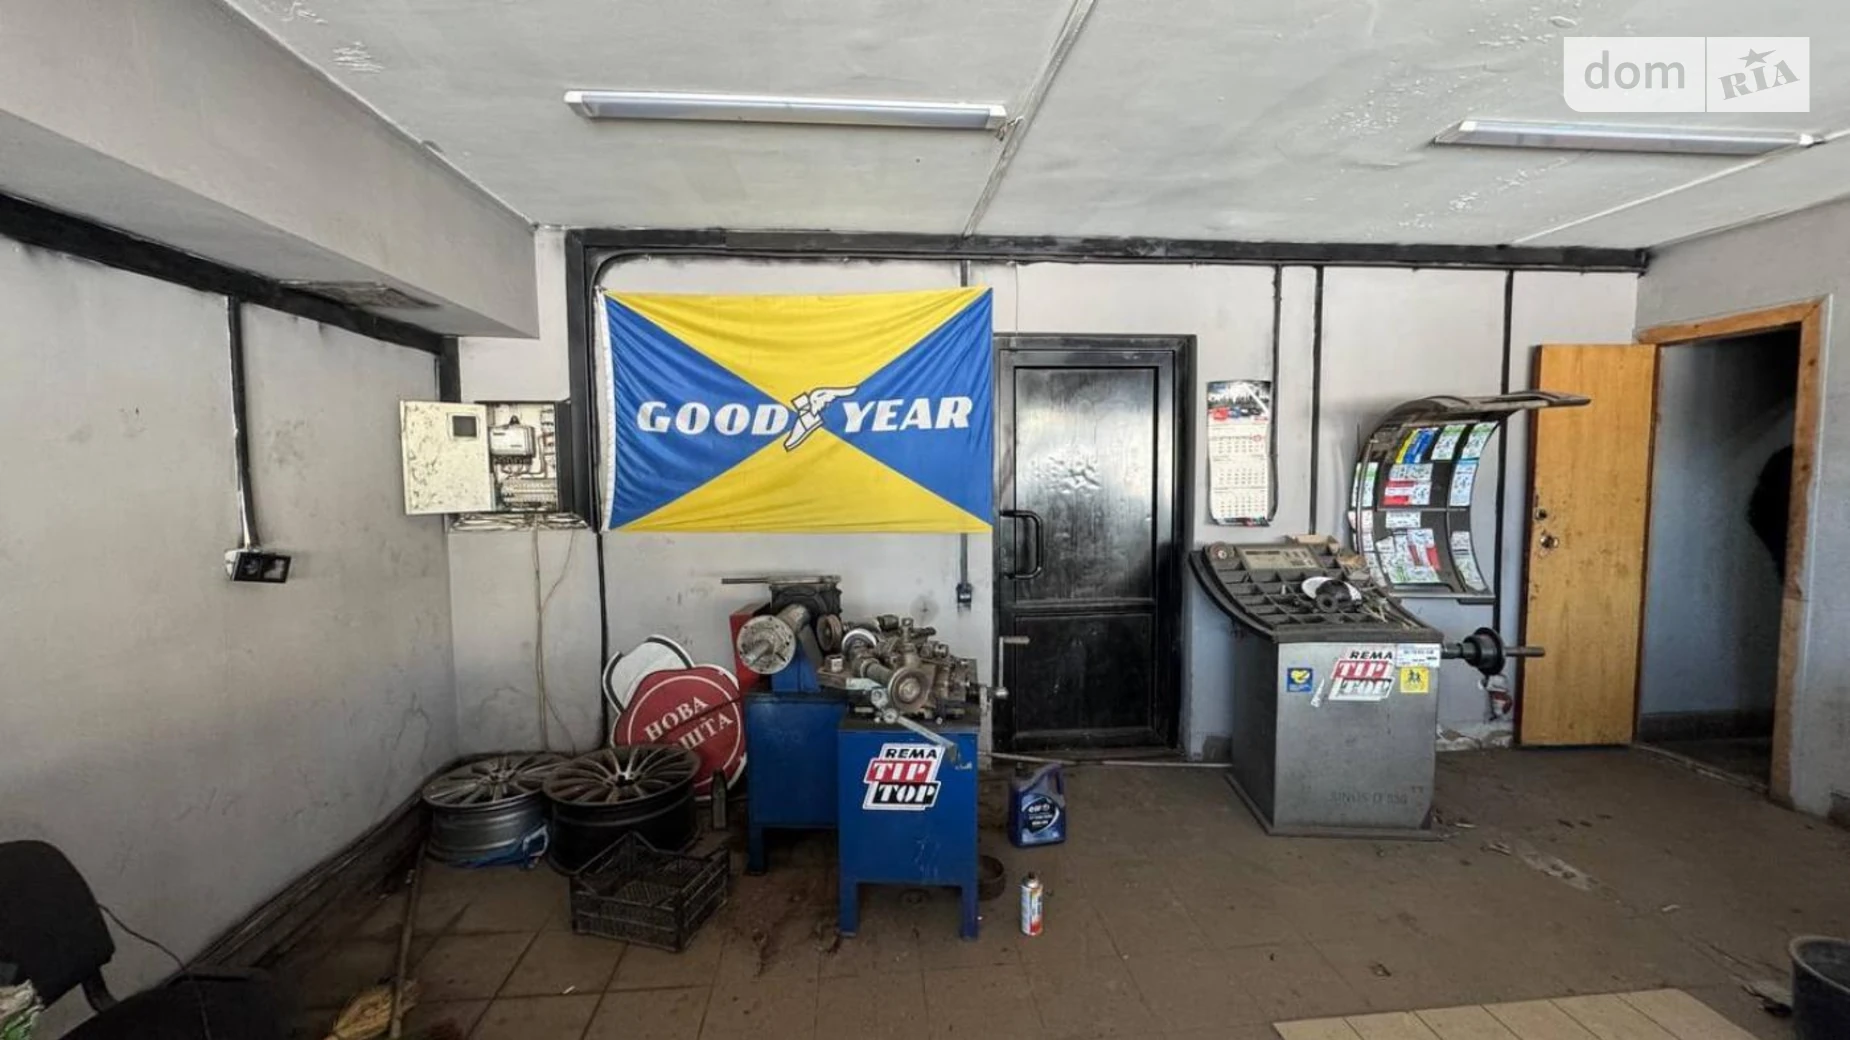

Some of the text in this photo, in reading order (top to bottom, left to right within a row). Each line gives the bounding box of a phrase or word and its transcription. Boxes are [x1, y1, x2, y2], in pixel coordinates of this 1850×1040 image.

[1350, 651, 1393, 660] REMA
[1337, 662, 1386, 679] TIP
[644, 696, 709, 742] НОВА
[678, 713, 734, 750] ШТА
[885, 748, 938, 759] REMA
[873, 762, 927, 781] TIP
[878, 784, 936, 803] TOP
